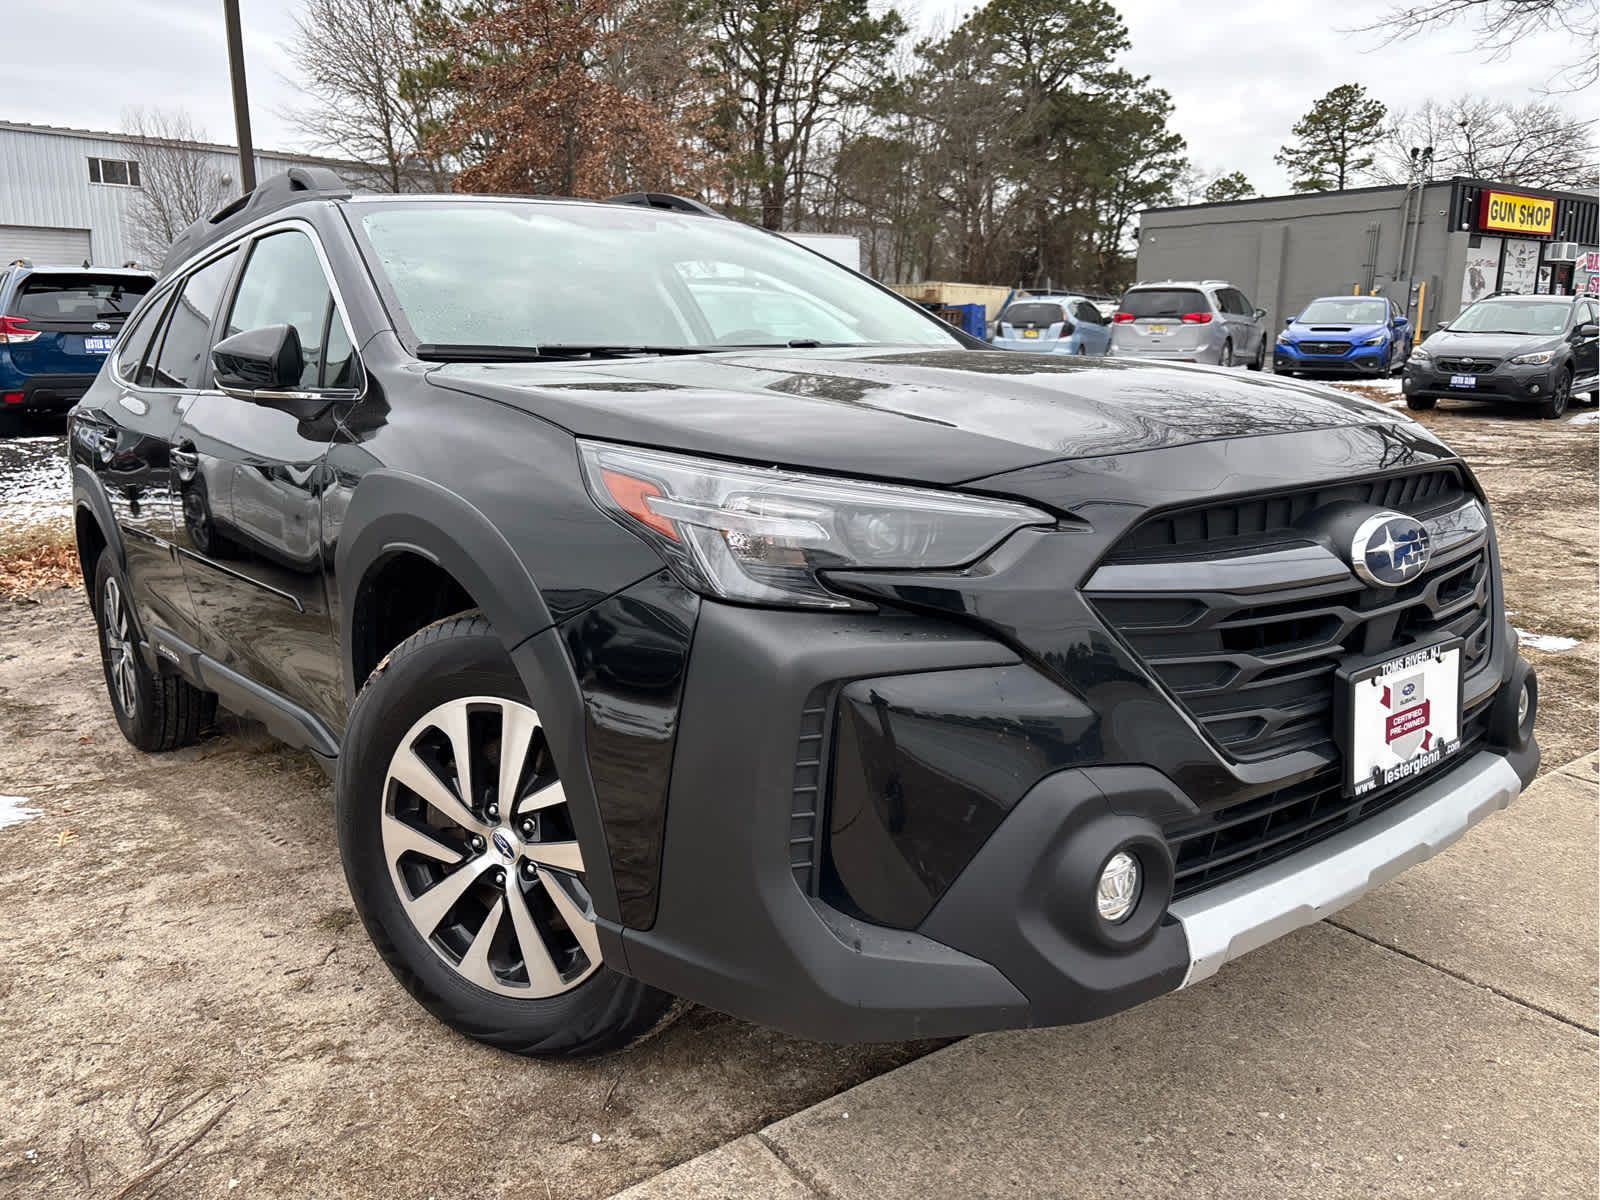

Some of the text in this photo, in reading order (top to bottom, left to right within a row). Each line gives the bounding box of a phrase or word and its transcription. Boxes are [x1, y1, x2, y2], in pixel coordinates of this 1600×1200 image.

[1490, 200, 1551, 226] GUN SHOP
[1382, 657, 1402, 676] TOMS
[1431, 646, 1441, 660] NJ
[1390, 716, 1425, 736] PRE-OWNED
[1393, 708, 1423, 726] CERTIFIED
